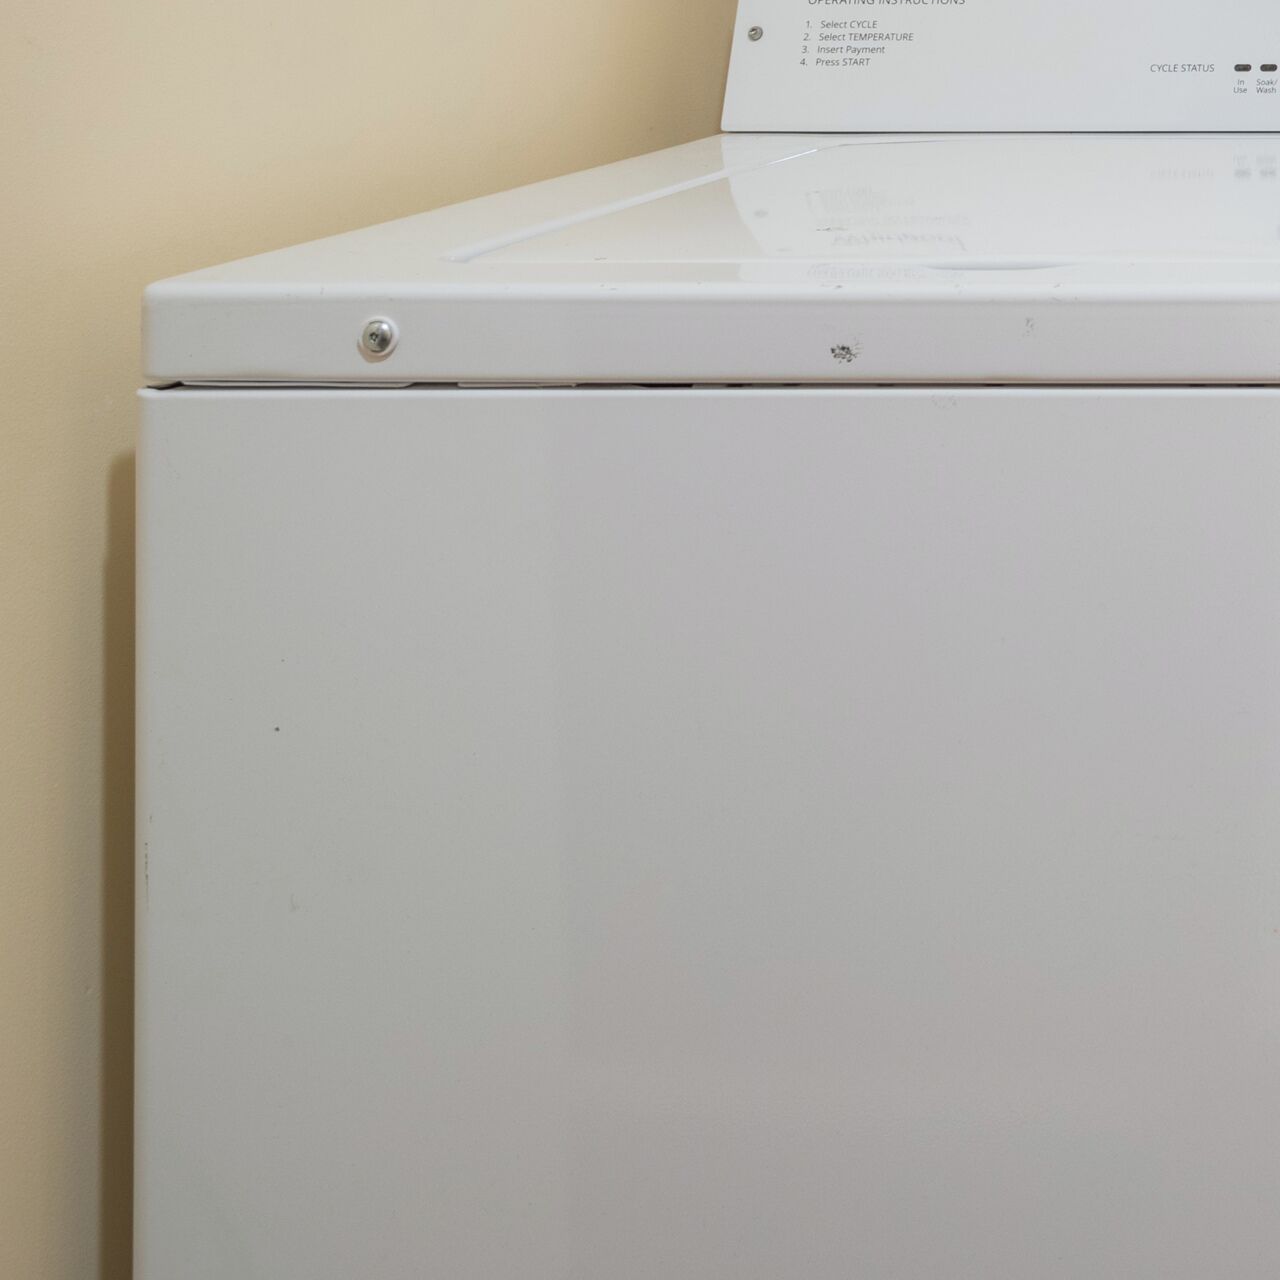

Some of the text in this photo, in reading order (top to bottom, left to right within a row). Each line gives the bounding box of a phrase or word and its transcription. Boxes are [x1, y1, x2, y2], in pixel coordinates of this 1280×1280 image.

[806, 20, 878, 29] 1. Select CYCLE
[803, 33, 914, 42] 2. Select TEMPERATURE
[802, 45, 885, 56] 3. Insert Payment
[800, 57, 871, 67] 4. Press START
[1150, 64, 1215, 73] CYCLE STATUS
